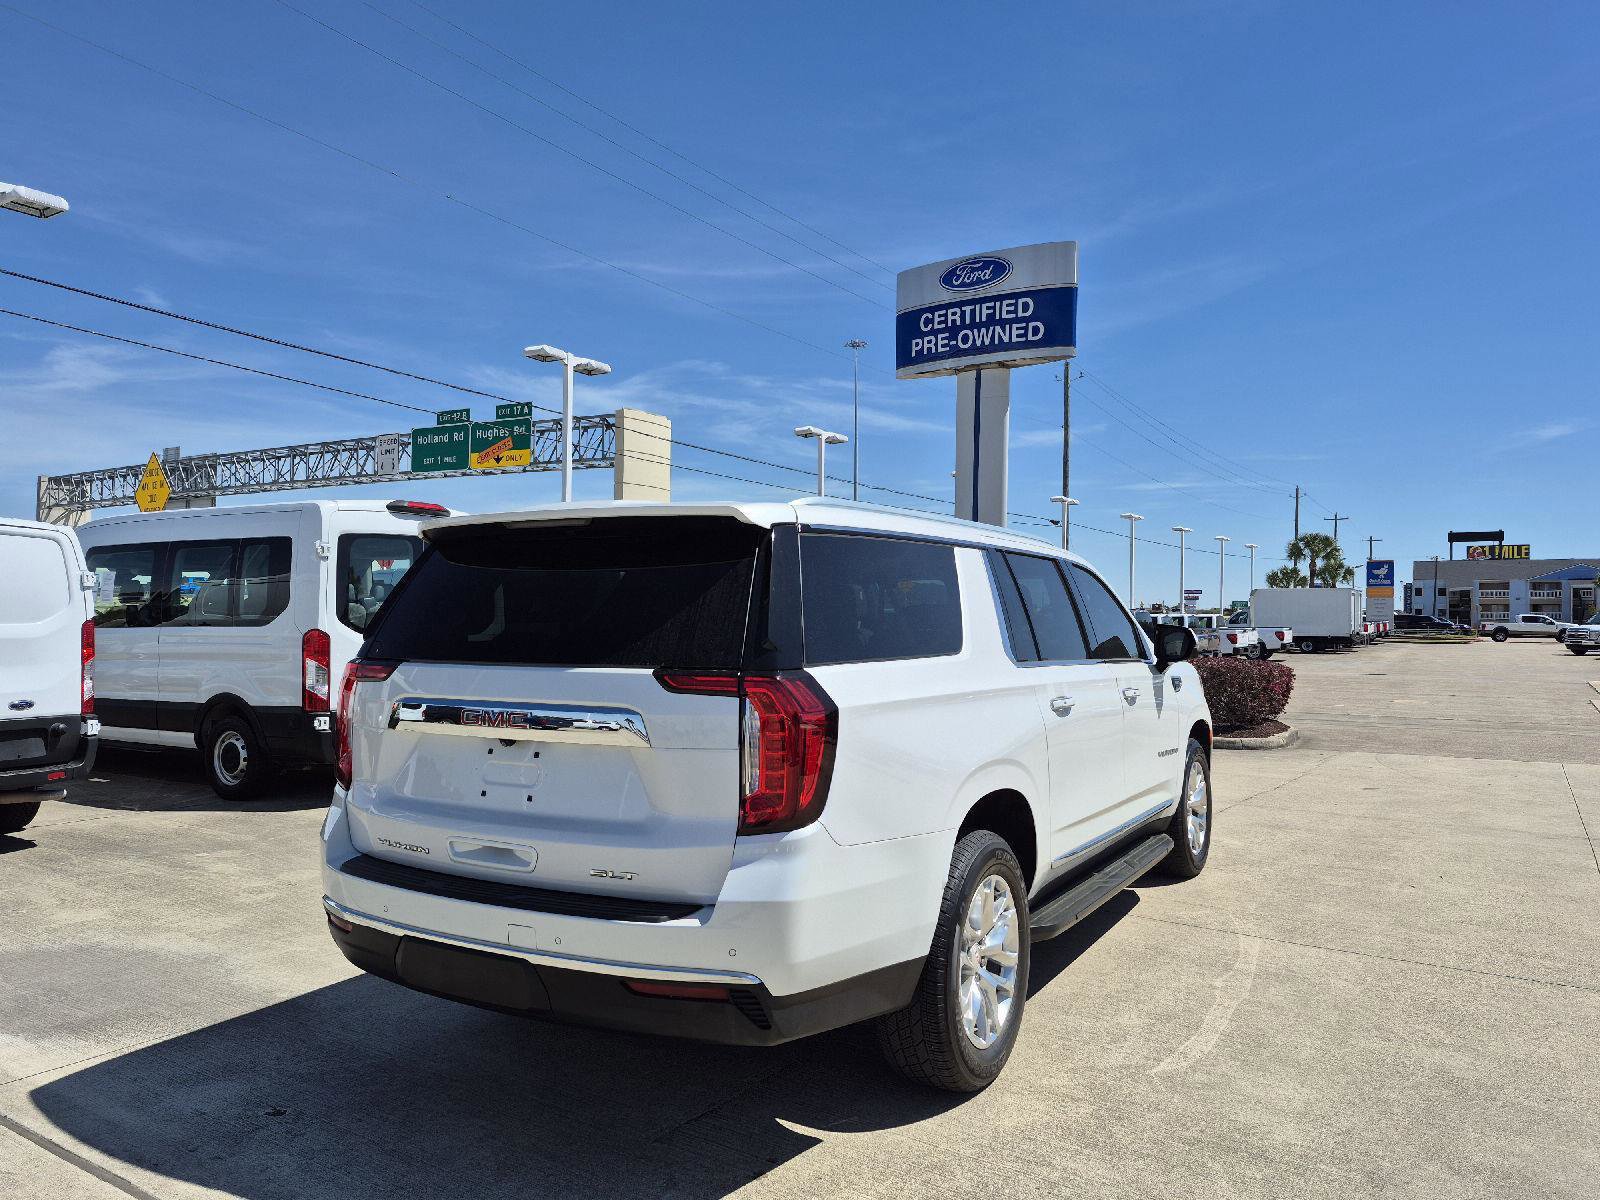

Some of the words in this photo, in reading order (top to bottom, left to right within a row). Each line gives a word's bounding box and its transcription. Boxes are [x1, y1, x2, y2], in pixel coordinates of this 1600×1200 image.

[952, 261, 994, 286] Ford
[919, 297, 1035, 332] CERTIFIED
[911, 321, 1045, 358] PRE-OWNED
[498, 408, 511, 416] EXIT
[513, 405, 522, 415] 17
[523, 405, 529, 415] A
[417, 433, 449, 445] Holland
[453, 431, 464, 442] Rd
[476, 427, 509, 440] Hughes
[380, 448, 396, 456] LIMIT
[505, 454, 523, 462] ONLY
[423, 457, 435, 465] EXIT
[1495, 545, 1530, 559] MILE
[461, 708, 530, 730] GMC
[589, 868, 640, 881] SLT
